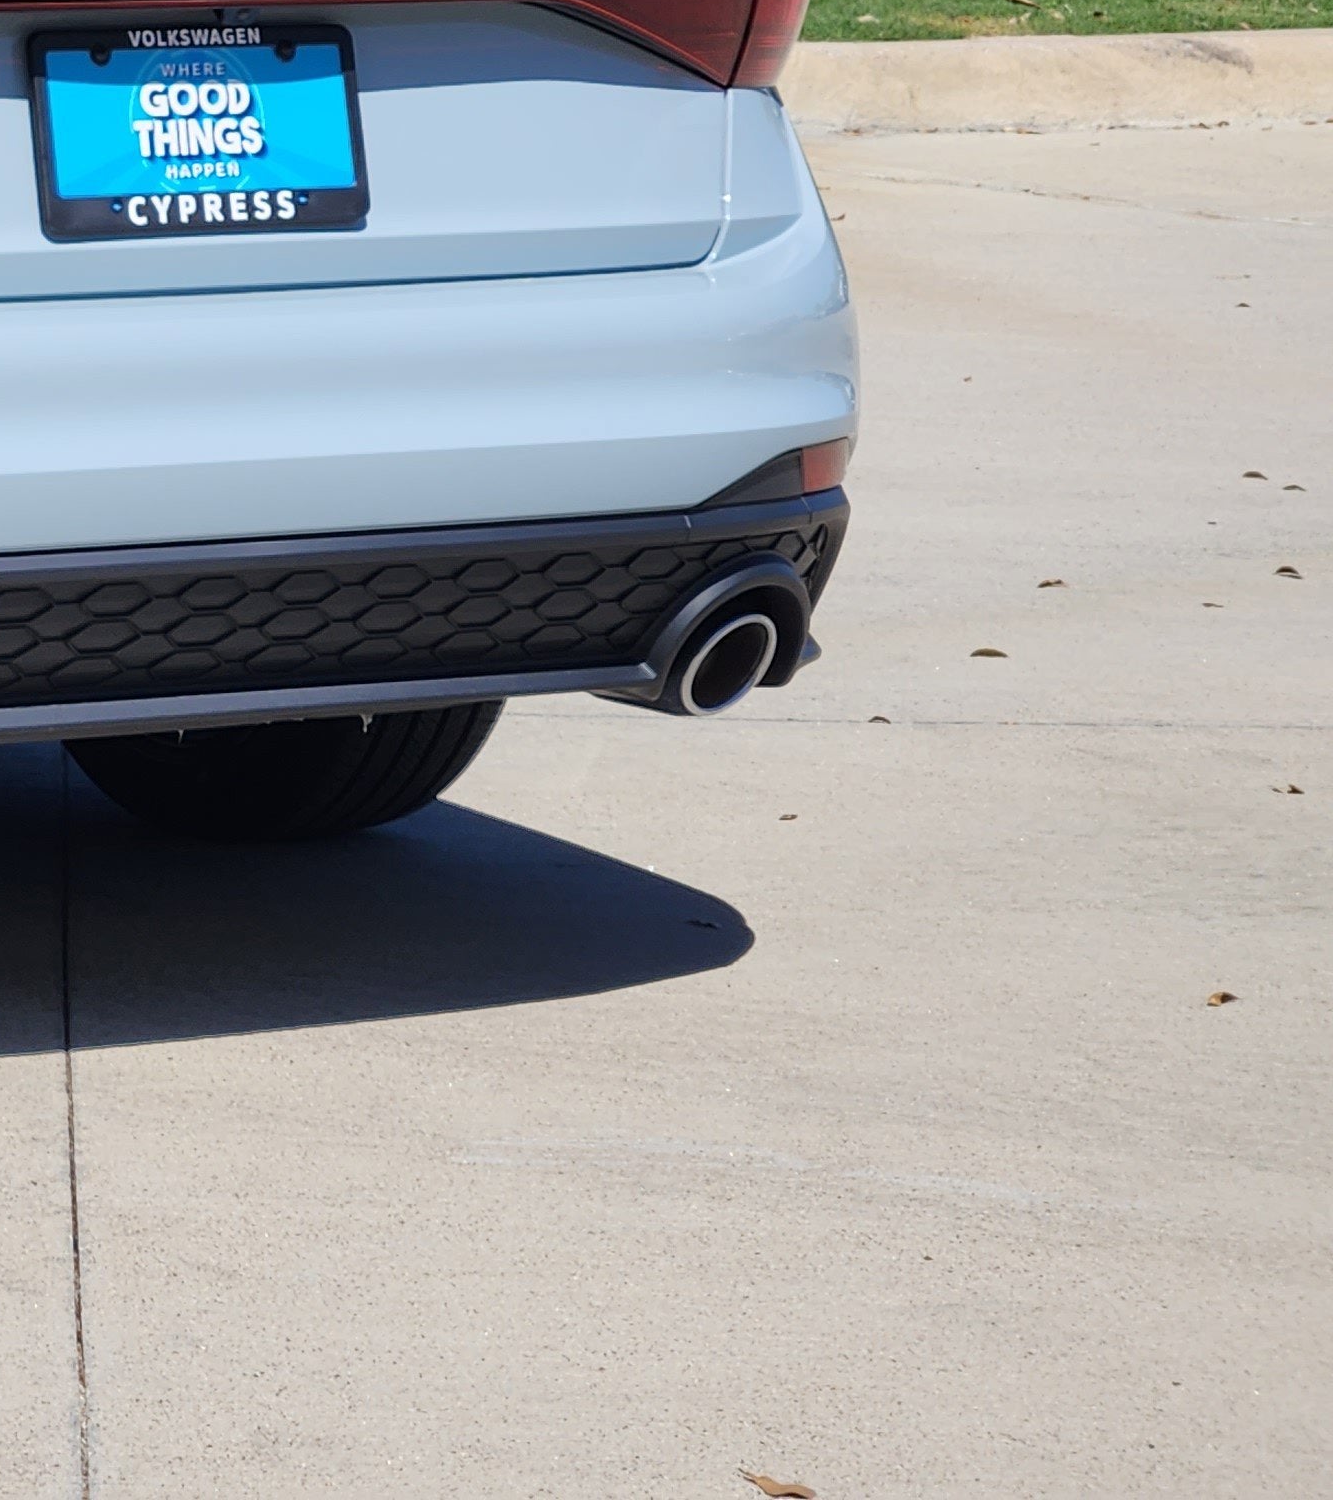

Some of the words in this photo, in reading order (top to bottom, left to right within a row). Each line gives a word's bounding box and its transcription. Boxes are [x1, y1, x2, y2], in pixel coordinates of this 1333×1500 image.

[128, 27, 261, 48] VOLKSWAGEN
[161, 62, 226, 78] WHERE
[139, 80, 251, 117] GOOD
[132, 117, 264, 158] THINGS
[165, 161, 240, 180] HAPPEN
[128, 190, 296, 226] CYPRESS
